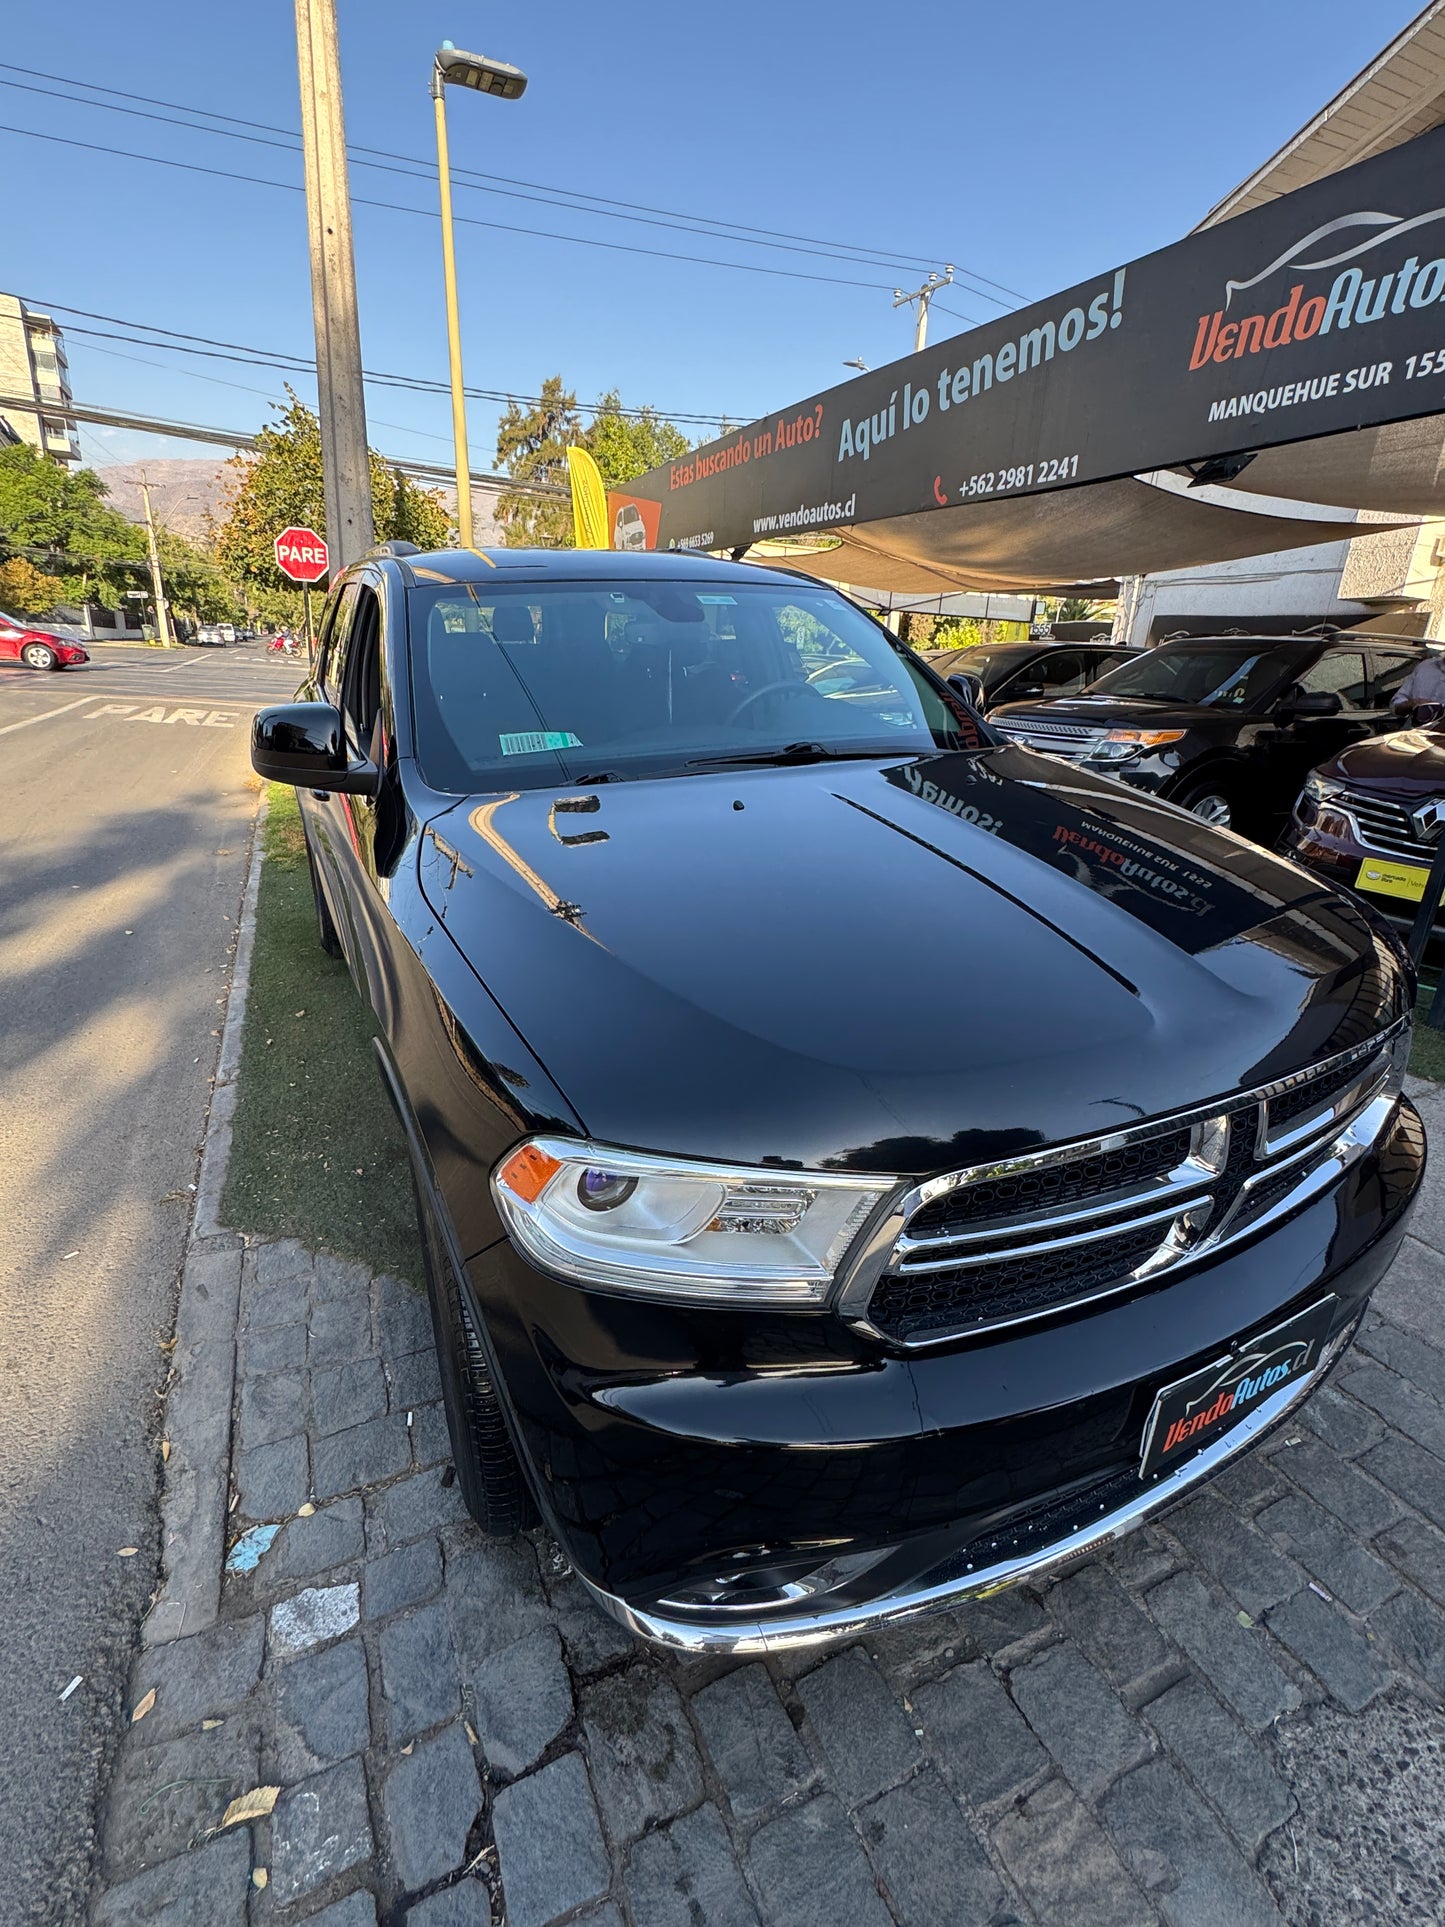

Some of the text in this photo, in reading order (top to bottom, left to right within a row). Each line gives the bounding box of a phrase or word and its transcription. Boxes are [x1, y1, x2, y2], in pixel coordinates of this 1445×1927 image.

[1188, 256, 1445, 372] VendoAuto
[838, 267, 1127, 463] Aquí lo tenemos!
[1207, 373, 1341, 423] MANQUEHUE
[1342, 361, 1393, 393] SUR
[670, 403, 824, 491] Estas buscando un Auto?
[959, 454, 1079, 497] +562 2981 2241
[753, 493, 856, 533] www.vendoautos.cl
[278, 544, 326, 565] PARE
[82, 703, 241, 728] PARE
[1162, 1338, 1316, 1453] VendoAutos.cl
